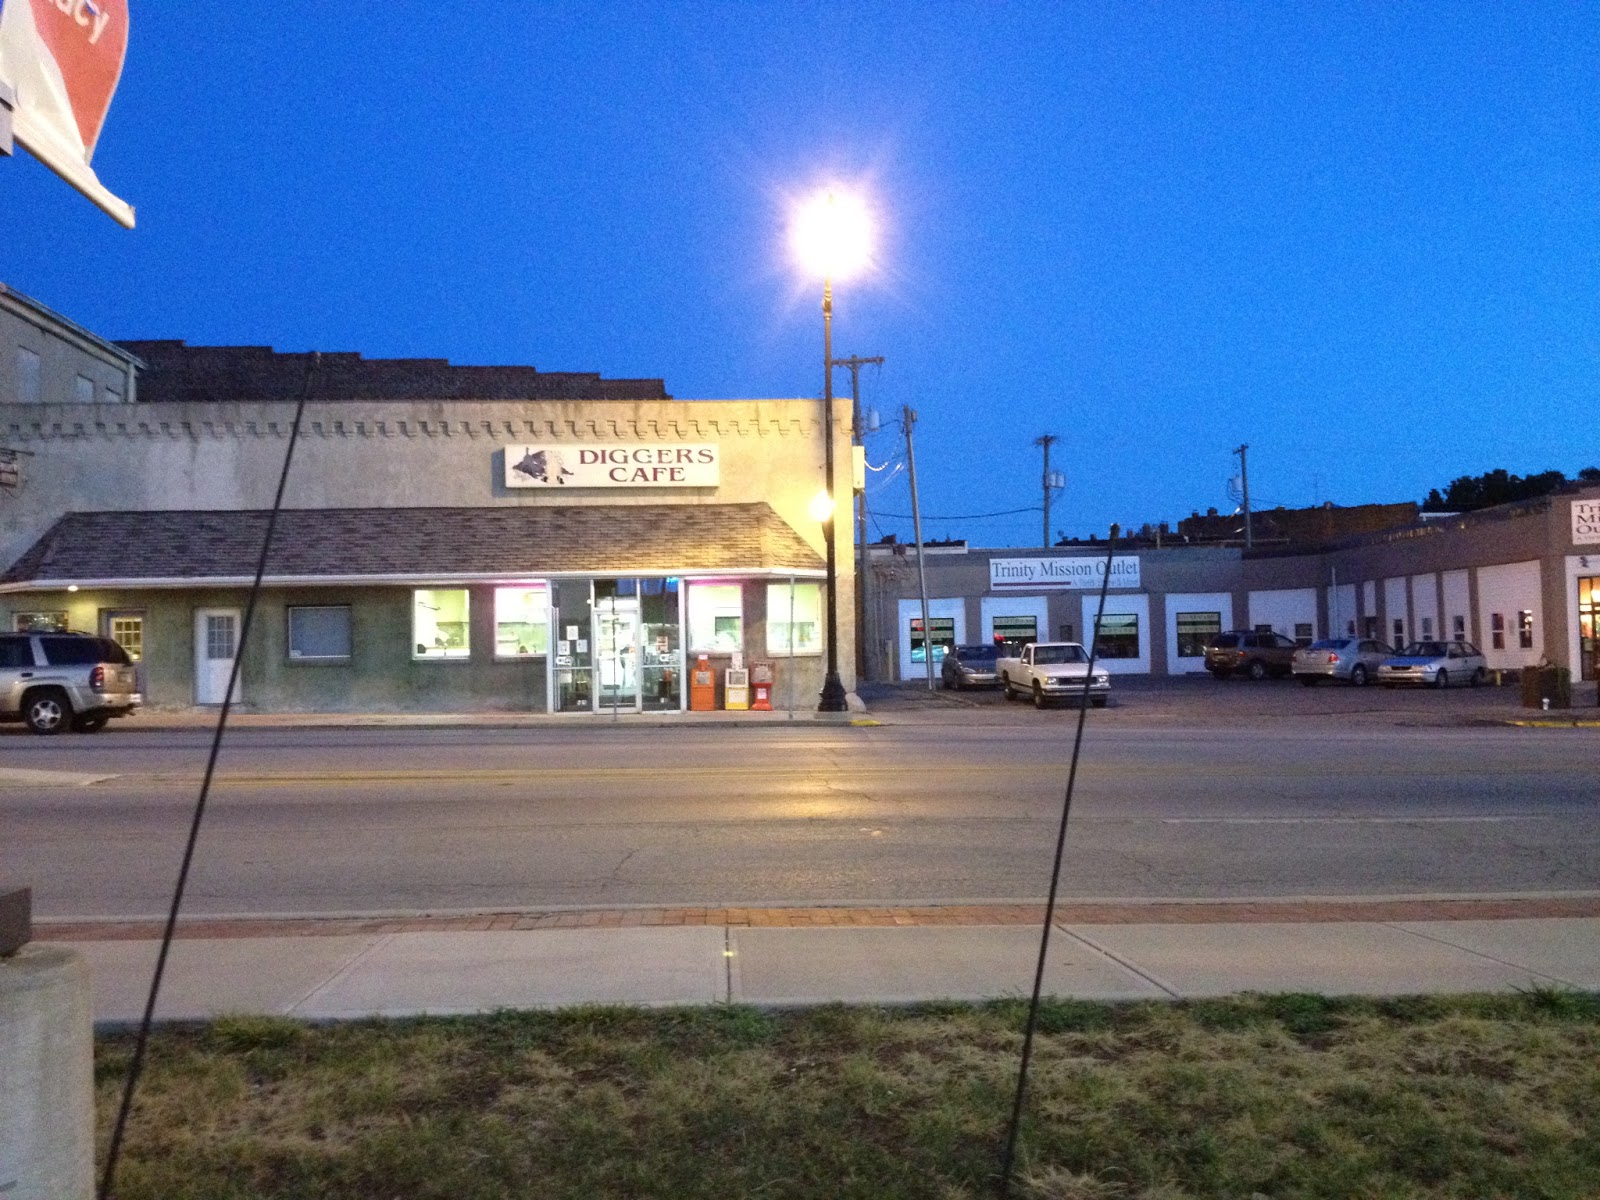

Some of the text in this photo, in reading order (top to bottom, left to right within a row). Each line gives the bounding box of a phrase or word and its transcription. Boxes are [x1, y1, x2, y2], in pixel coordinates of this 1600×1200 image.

[49, 0, 110, 45] acy
[579, 448, 714, 465] DIGGERS
[608, 466, 686, 482] CAFE
[992, 560, 1138, 581] Trinity Mission Outlet
